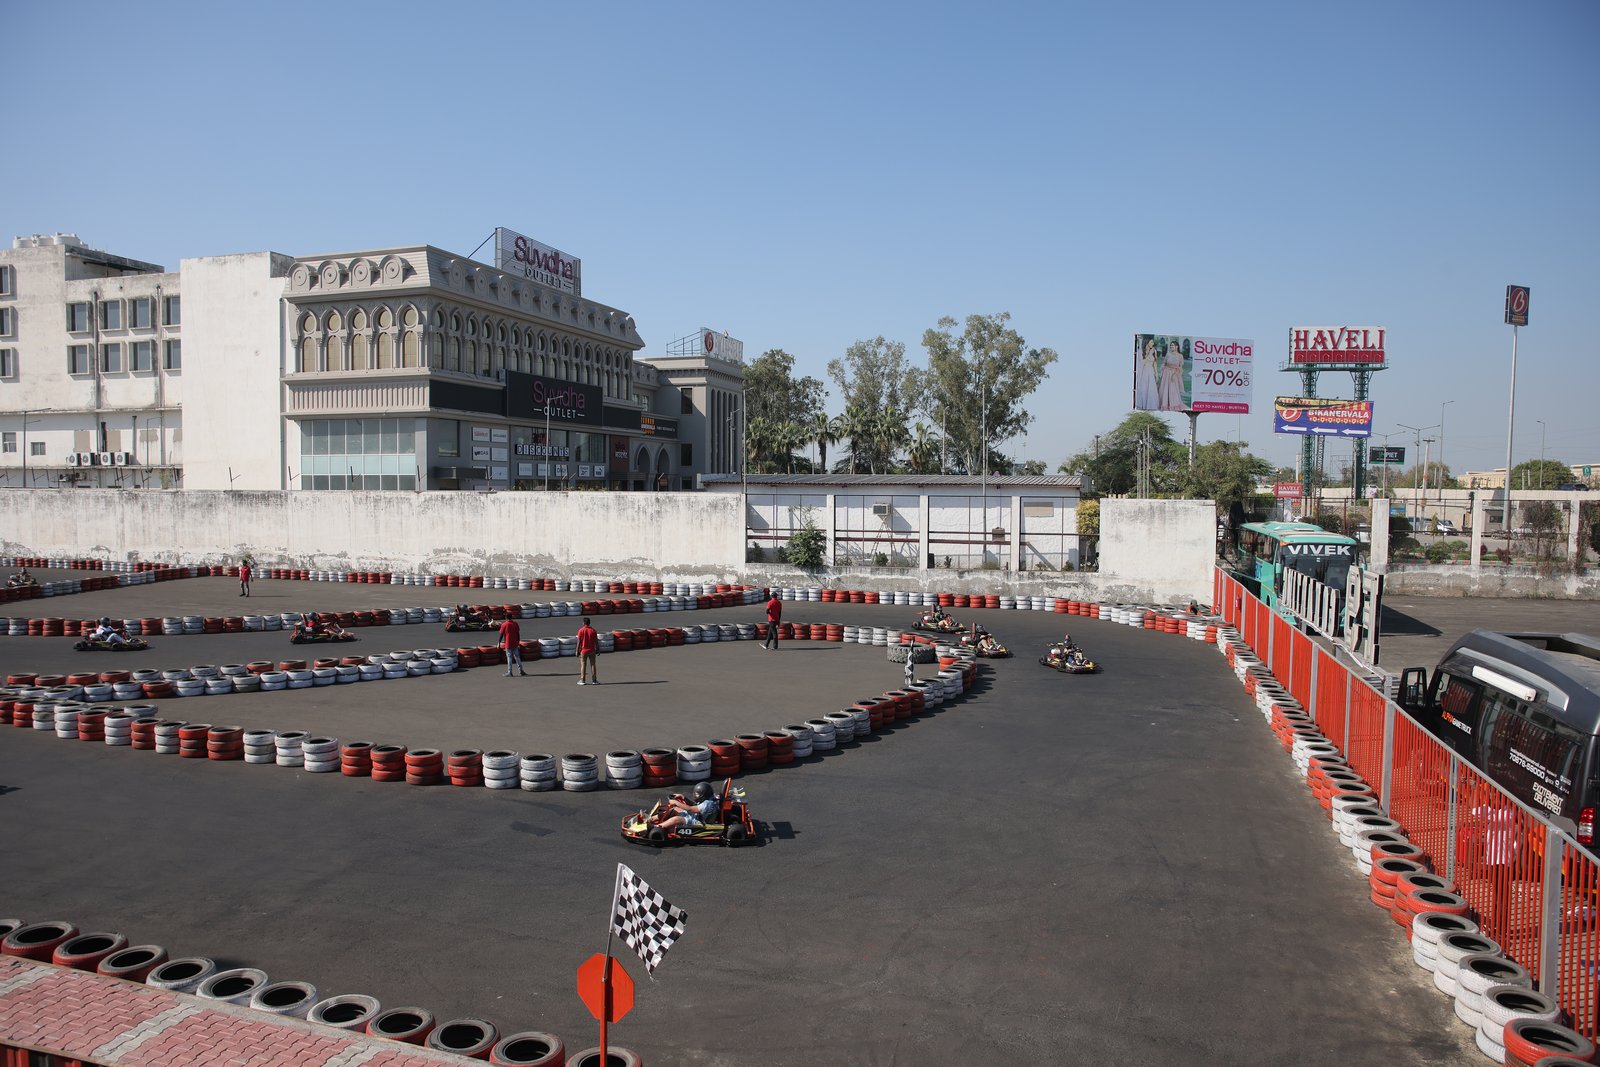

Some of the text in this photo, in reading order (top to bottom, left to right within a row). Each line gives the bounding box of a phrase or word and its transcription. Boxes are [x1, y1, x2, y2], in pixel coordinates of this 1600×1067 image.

[514, 236, 573, 279] Suvidha
[526, 267, 561, 288] OUTLET
[1294, 326, 1385, 350] HAVELI
[1194, 341, 1252, 356] Suvidha
[1203, 369, 1243, 386] 70%
[534, 380, 585, 409] Suvidha
[544, 406, 576, 418] OUTLET
[1308, 410, 1369, 419] BIKANERVALA
[1287, 544, 1351, 556] VIVEK
[1533, 792, 1562, 816] DELIVERED
